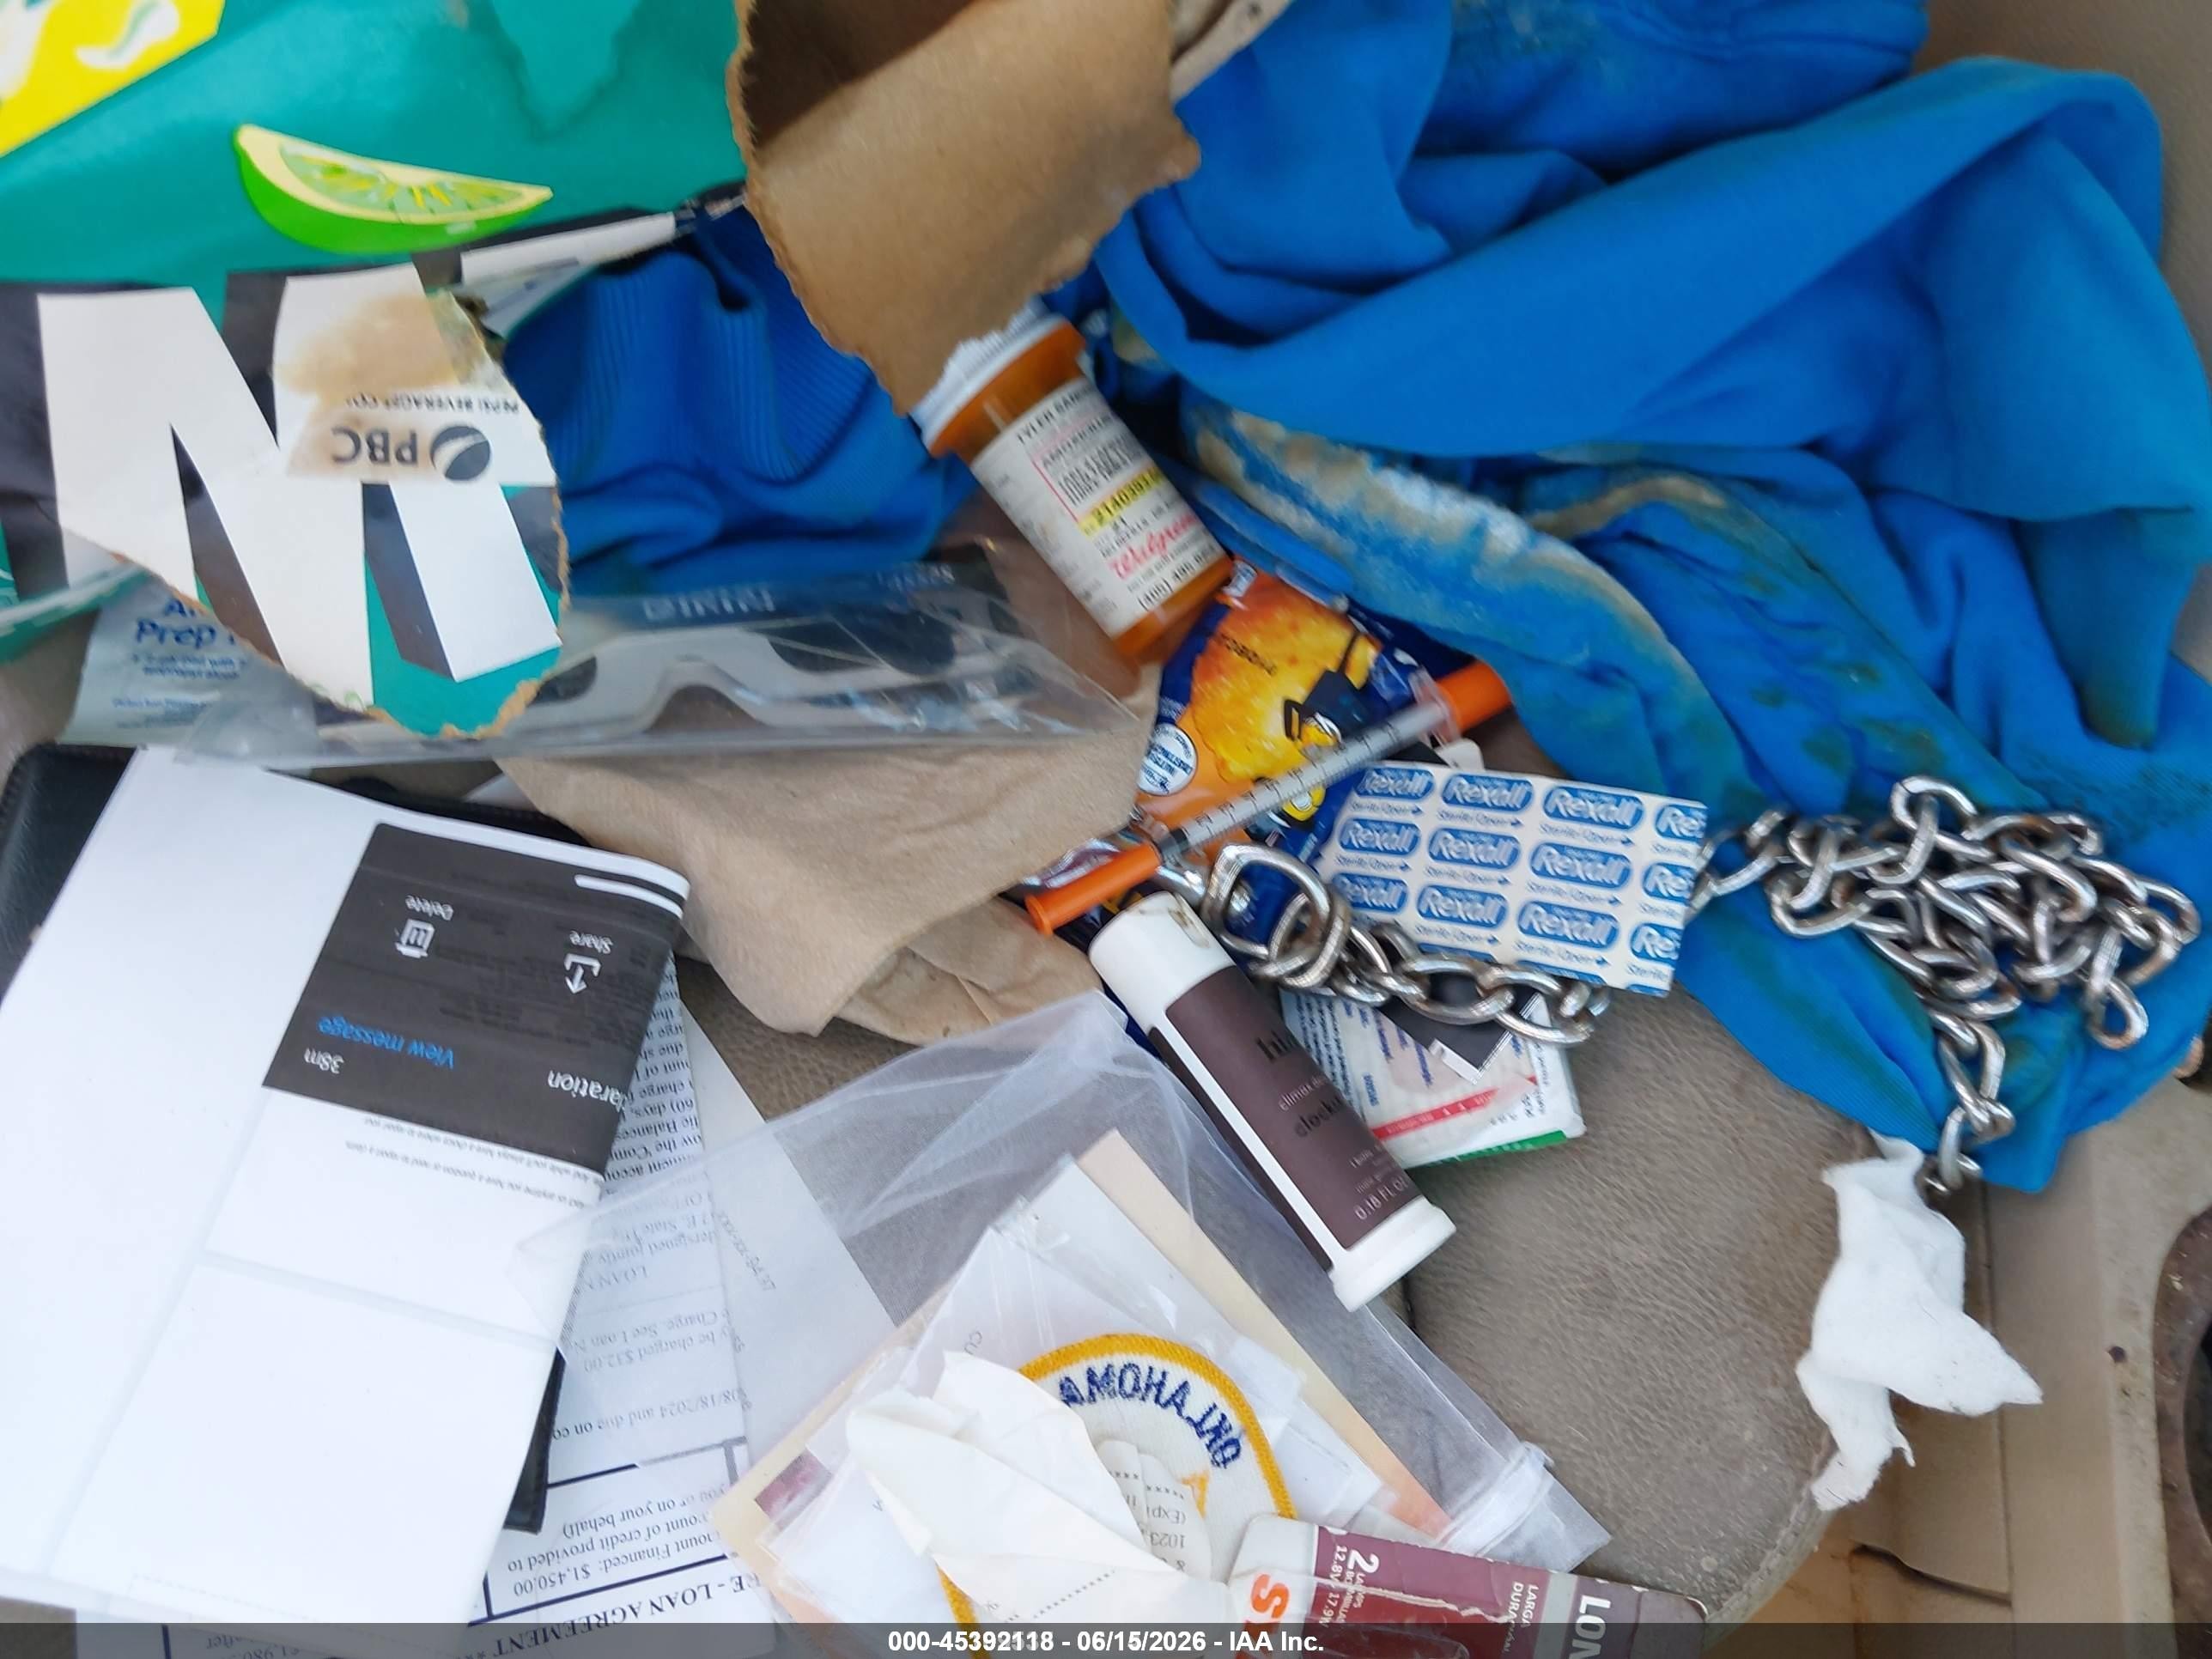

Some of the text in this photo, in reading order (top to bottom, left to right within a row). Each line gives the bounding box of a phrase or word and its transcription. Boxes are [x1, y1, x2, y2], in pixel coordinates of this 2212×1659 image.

[331, 428, 418, 466] PBC
[135, 619, 217, 649] Prep
[1443, 774, 1532, 809] Rexall
[1546, 788, 1641, 827] Rexall
[1340, 820, 1417, 854] Rexall
[1429, 829, 1518, 867] Rexall
[1531, 844, 1631, 885] Rexall
[404, 894, 456, 921] Delete
[1419, 886, 1505, 925] Rexall
[1519, 903, 1618, 945] Rexall
[568, 930, 614, 955] Share
[317, 1015, 406, 1054] message
[304, 1048, 346, 1074] 38m
[407, 1040, 455, 1069] View
[574, 1421, 593, 1437] on
[629, 1407, 654, 1427] and
[617, 1500, 654, 1528] your
[655, 1498, 678, 1516] on
[561, 1514, 617, 1542] behalf)
[598, 1529, 643, 1554] credit
[643, 1523, 662, 1542] of
[505, 1558, 524, 1577] to
[526, 1535, 596, 1571] provided
[596, 1541, 672, 1577] Financed:
[1348, 1549, 1379, 1573] 2
[510, 1562, 592, 1599] $1,450.00
[647, 1583, 713, 1618] LOAN
[1520, 1584, 1540, 1628] LARGA
[491, 1602, 646, 1656] AGREEMENT
